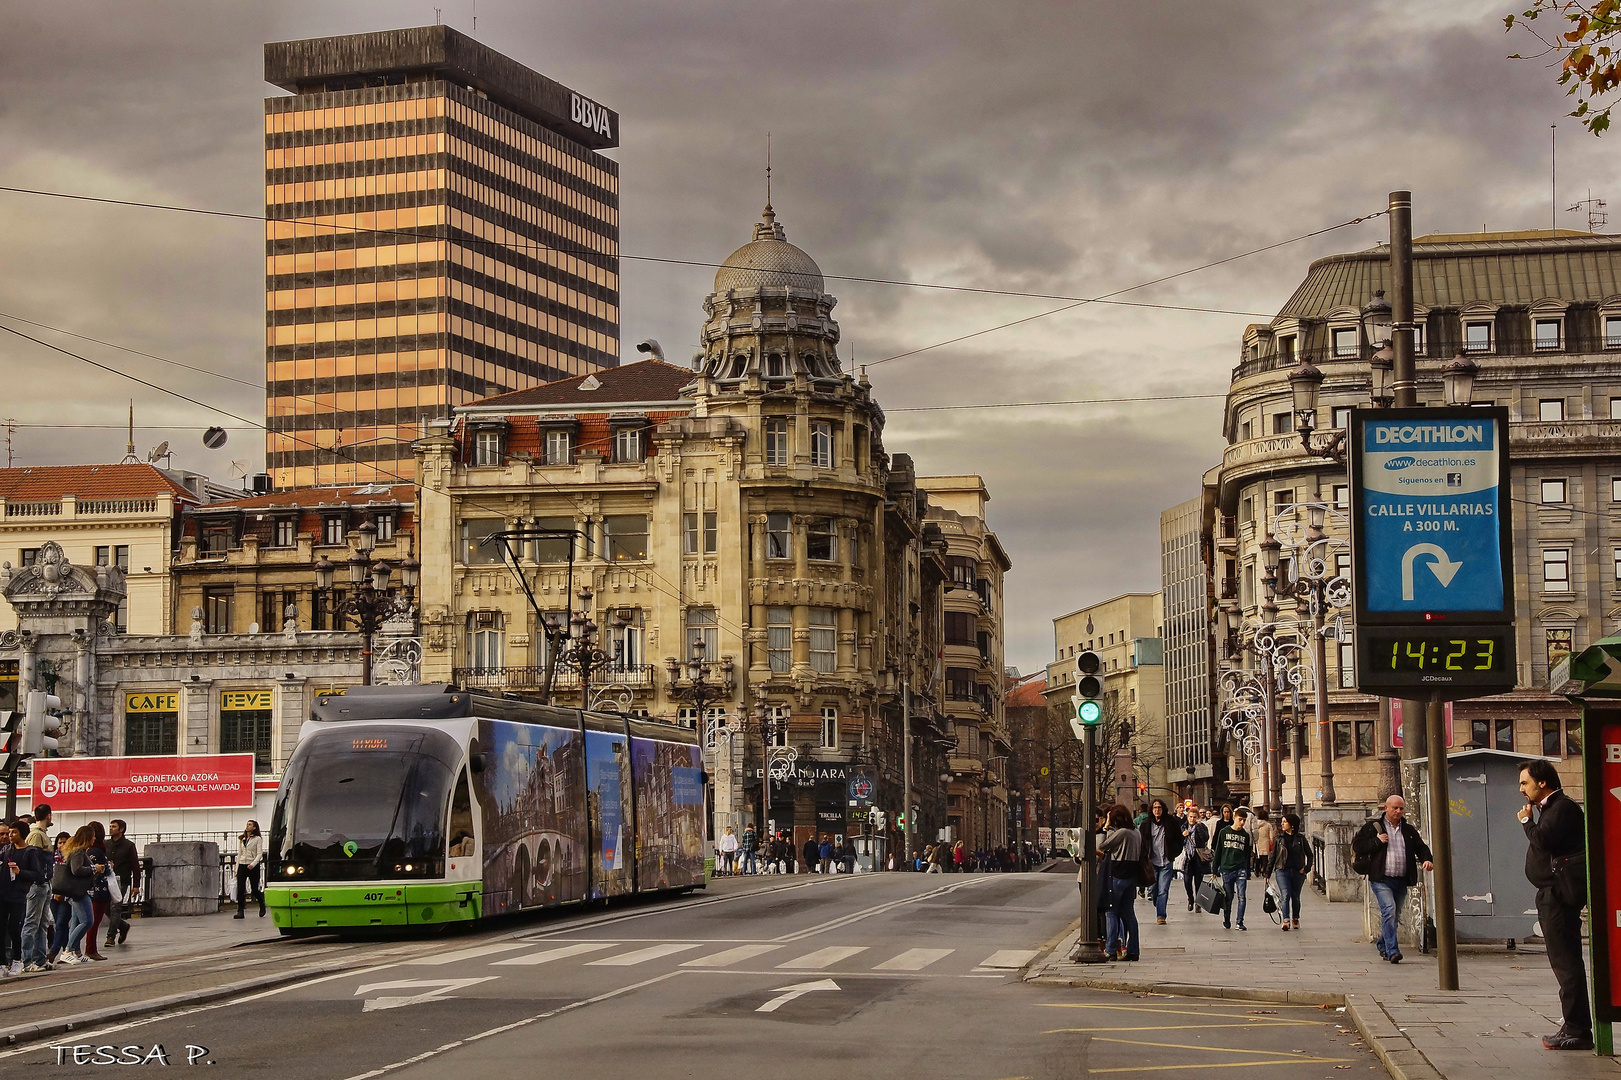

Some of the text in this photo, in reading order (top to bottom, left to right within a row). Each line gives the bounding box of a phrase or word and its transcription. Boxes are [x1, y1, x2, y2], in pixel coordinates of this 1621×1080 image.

[571, 92, 611, 139] BBVA
[1375, 425, 1483, 444] DECATHLON
[1386, 457, 1476, 467] www.decathlon.es
[1398, 476, 1433, 485] Síguenos
[1367, 503, 1494, 516] CALLE VILLARIAS
[1403, 520, 1460, 532] A 300 M.
[1391, 640, 1494, 670] 14:23
[128, 695, 176, 710] CAFE
[223, 693, 271, 708] FEVE
[131, 773, 219, 783] GABONETAKO AZOKA
[40, 774, 94, 798] Bilbao
[110, 786, 148, 794] MERCADO
[149, 785, 196, 793] TRADICIONAL
[208, 783, 240, 791] NAVIDAD
[364, 893, 384, 901] 407
